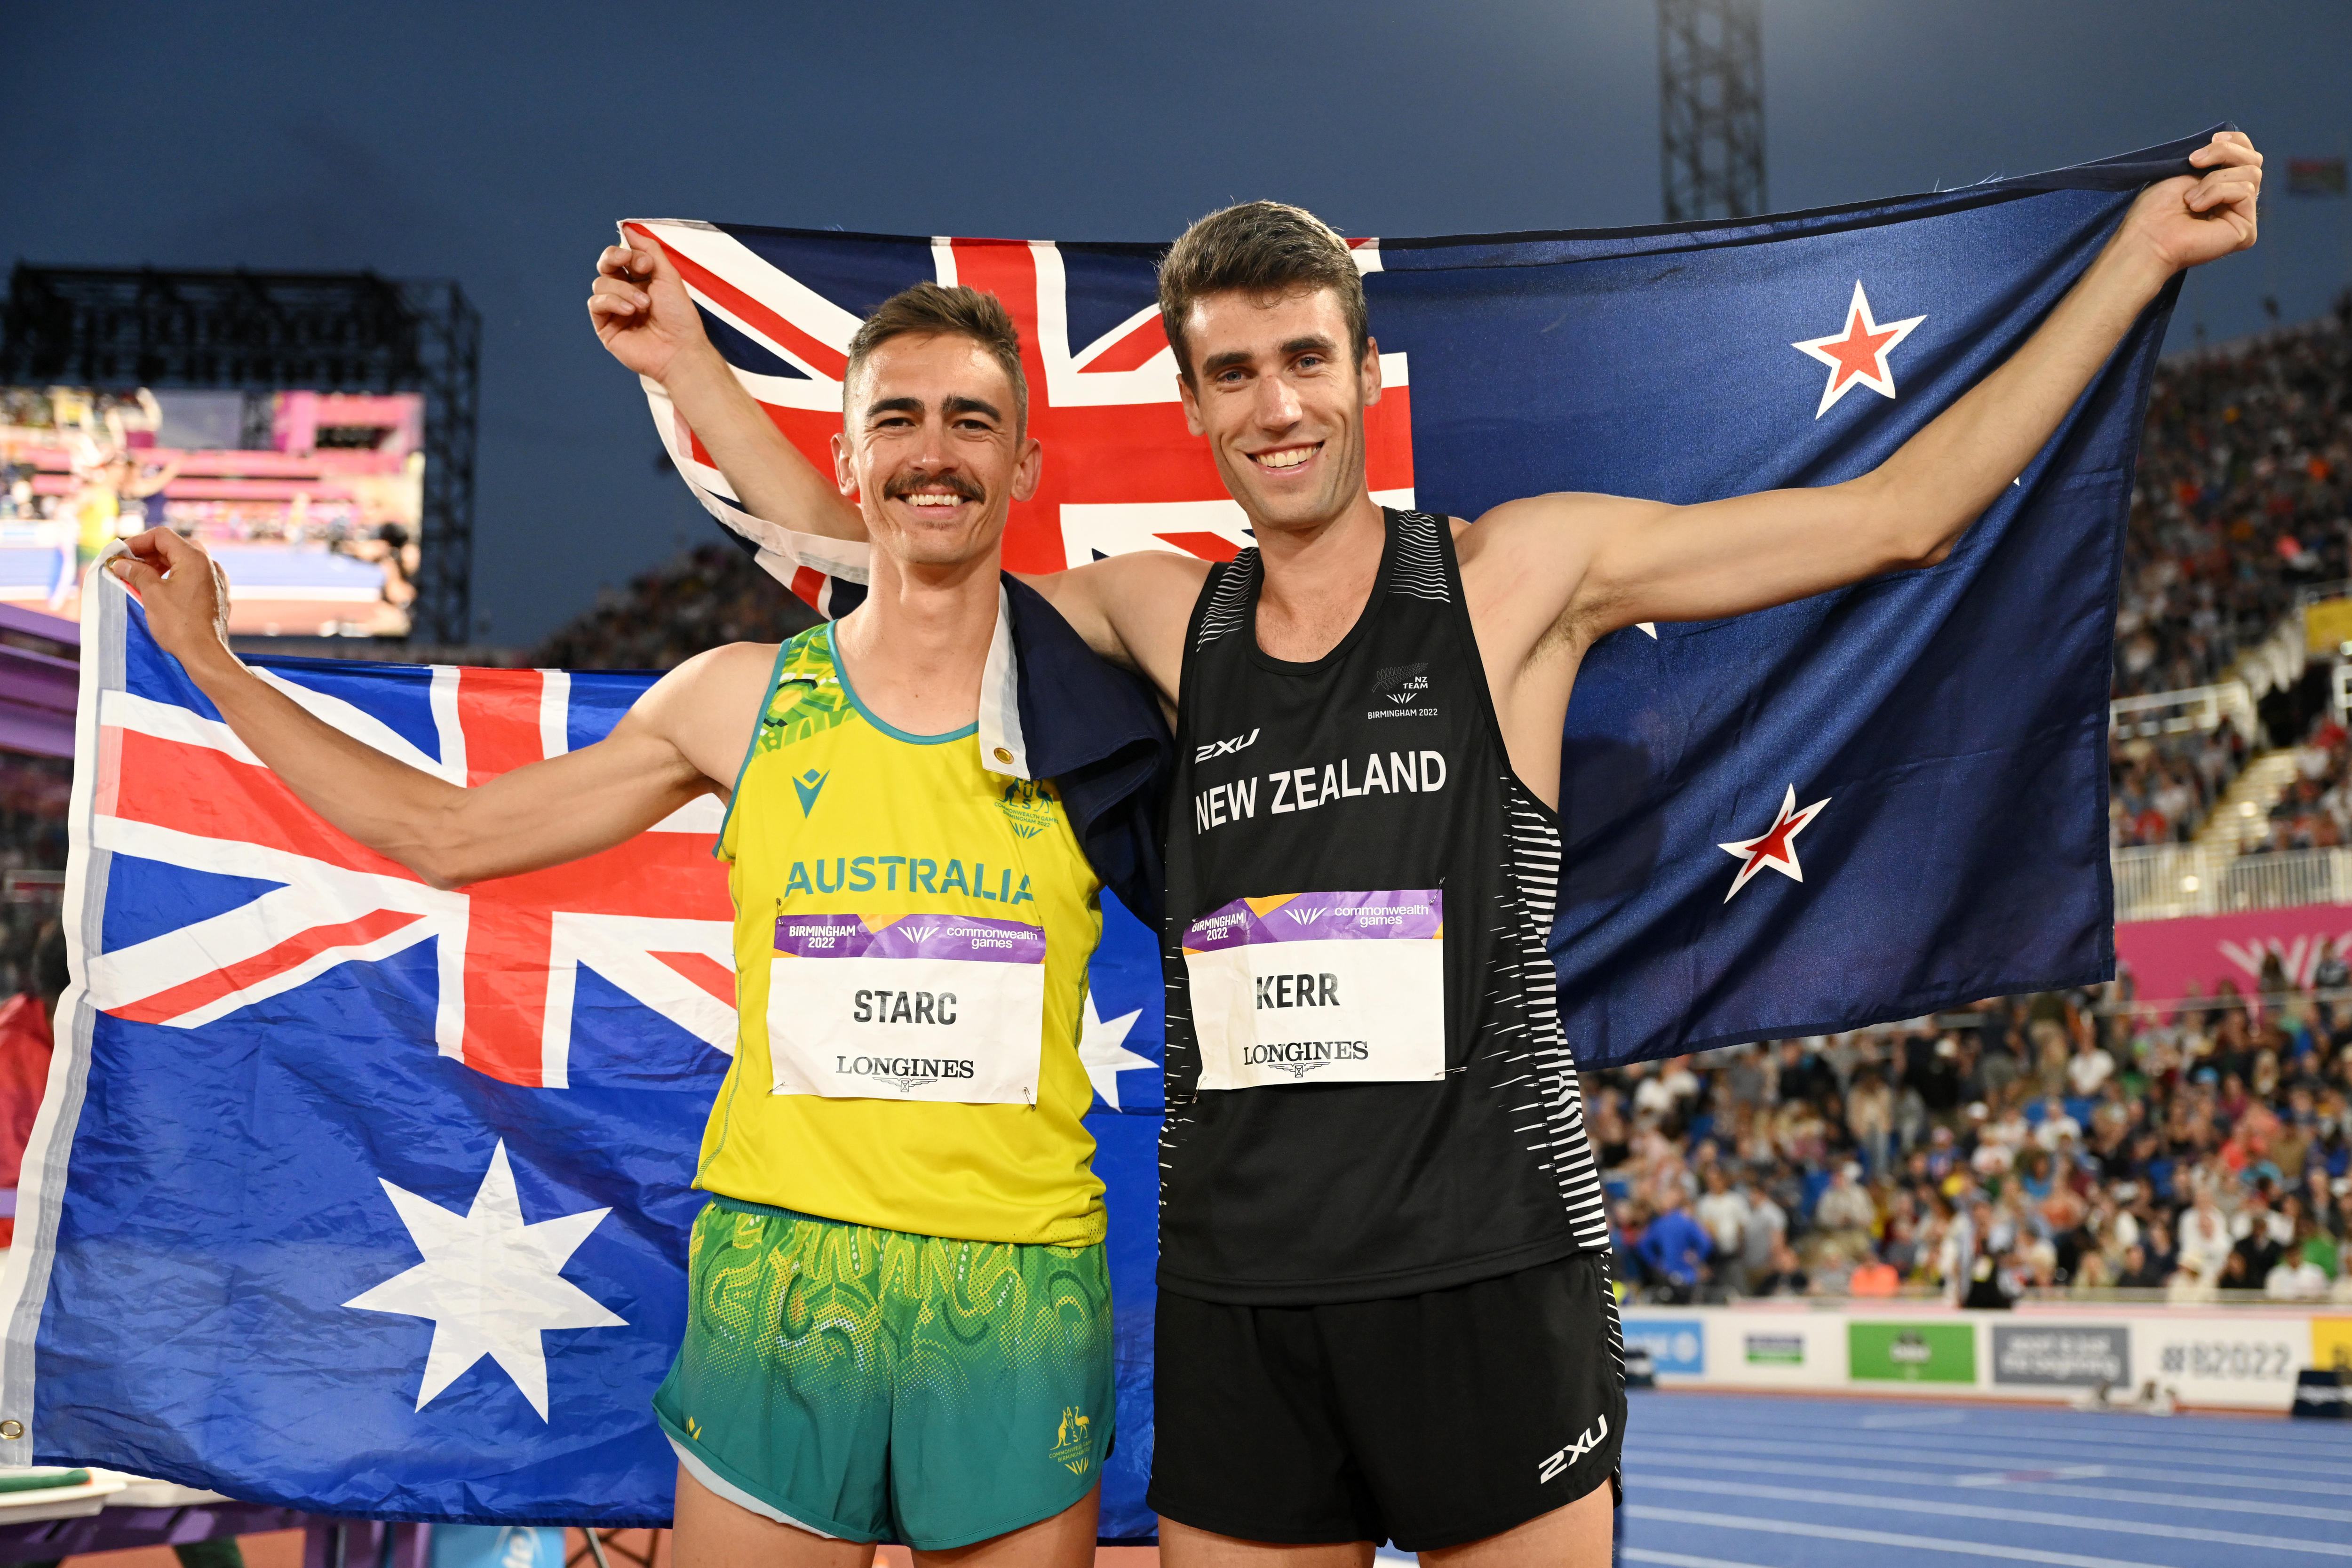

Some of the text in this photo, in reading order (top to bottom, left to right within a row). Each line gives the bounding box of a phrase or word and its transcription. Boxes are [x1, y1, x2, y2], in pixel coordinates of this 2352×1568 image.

[1367, 709, 1417, 719] BIRMINGHAM
[1195, 728, 1260, 764] 2XU
[1195, 750, 1446, 835] NEW ZEALAND
[994, 802, 1040, 820] COMMONWEALTH
[1003, 810, 1036, 824] BIRMINGHAM
[784, 856, 1034, 905] AUSTRALIA
[1335, 905, 1429, 916] commonwealth
[789, 925, 856, 937] BIRMINGHAM
[1192, 912, 1244, 932] BIRMINGHAM
[1360, 916, 1403, 928] games
[808, 937, 835, 948] 2022
[946, 927, 1038, 940] commonwealth
[1207, 927, 1229, 941] 2022
[971, 938, 1013, 949] games
[1256, 973, 1340, 1010] KERR
[854, 989, 957, 1025] STARC
[1244, 1041, 1368, 1065] LONGINES
[836, 1056, 974, 1079] LONGINES
[1539, 1414, 1608, 1484] 2XU
